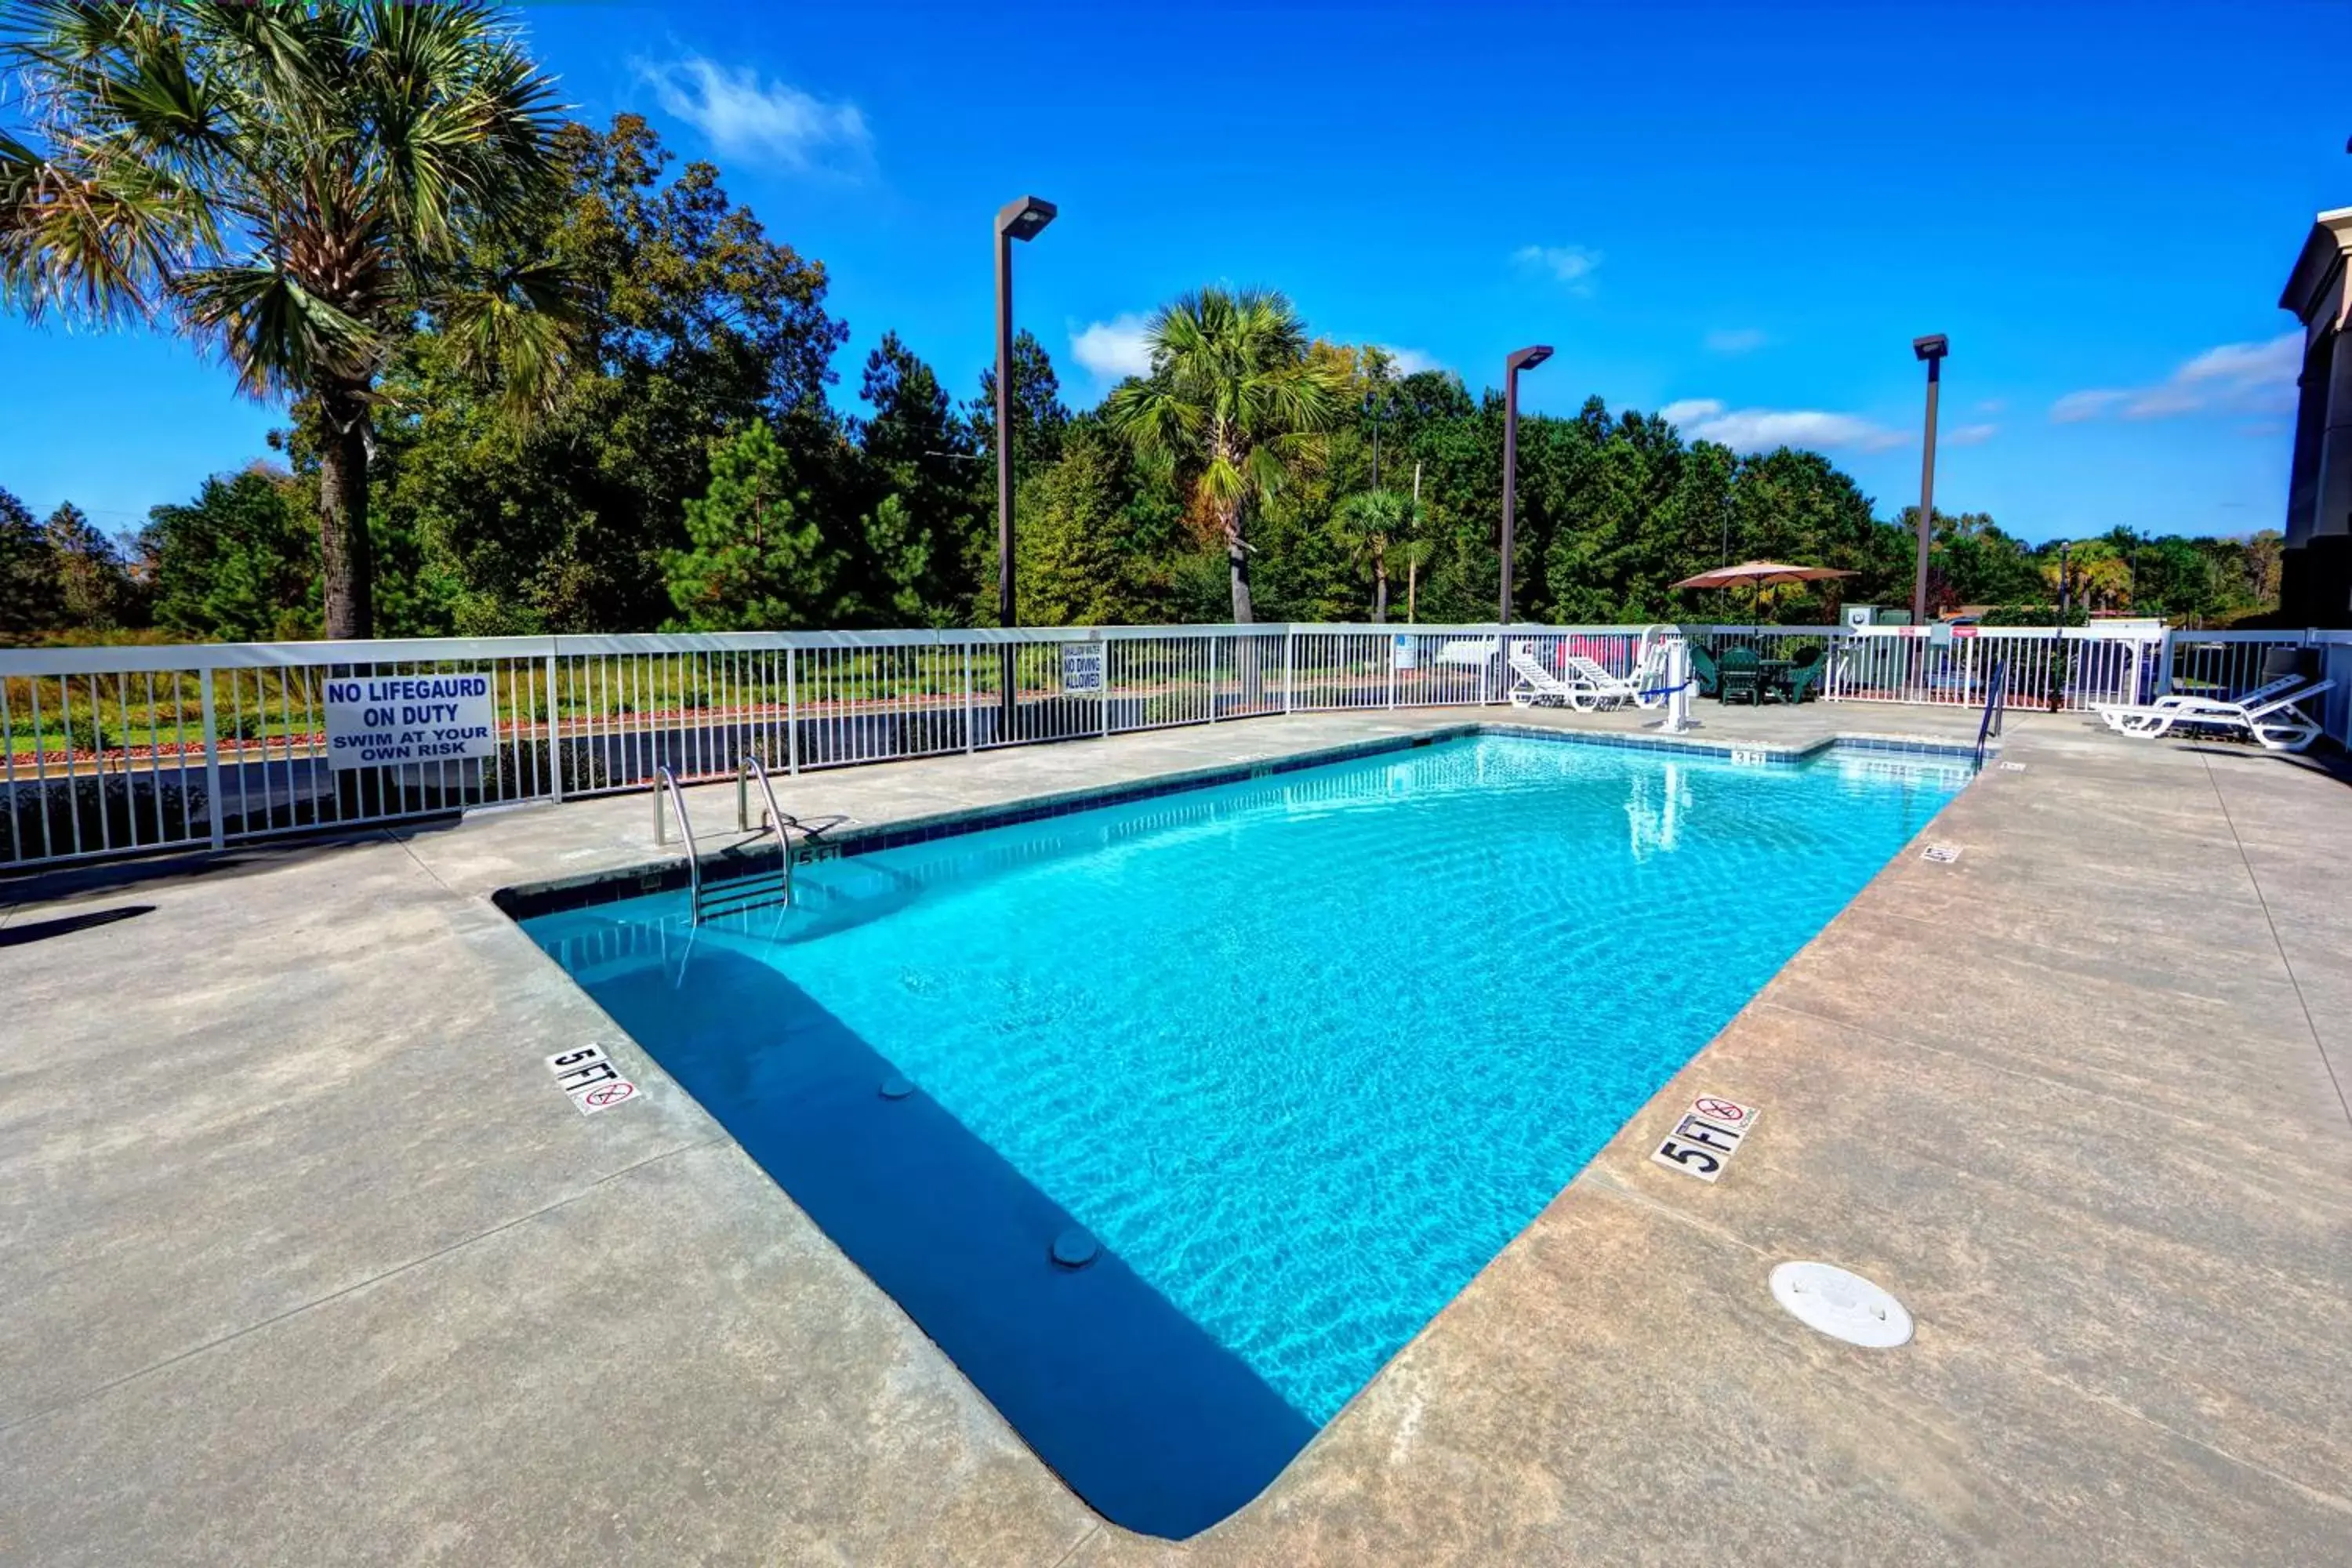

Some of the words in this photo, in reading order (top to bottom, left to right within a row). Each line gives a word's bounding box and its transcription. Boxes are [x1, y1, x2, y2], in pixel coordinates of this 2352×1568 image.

[1065, 658, 1075, 673] NO
[1076, 657, 1100, 672] DIVING
[328, 684, 361, 702] NO
[369, 678, 486, 702] LIFEGAURD
[1065, 673, 1100, 689] ALLOWED
[364, 708, 395, 727] ON
[402, 704, 459, 725] DUTY
[333, 732, 392, 749] SWIM
[401, 731, 426, 744] AT
[434, 727, 488, 741] YOUR
[361, 746, 410, 760] OWN
[418, 742, 466, 757] RISK
